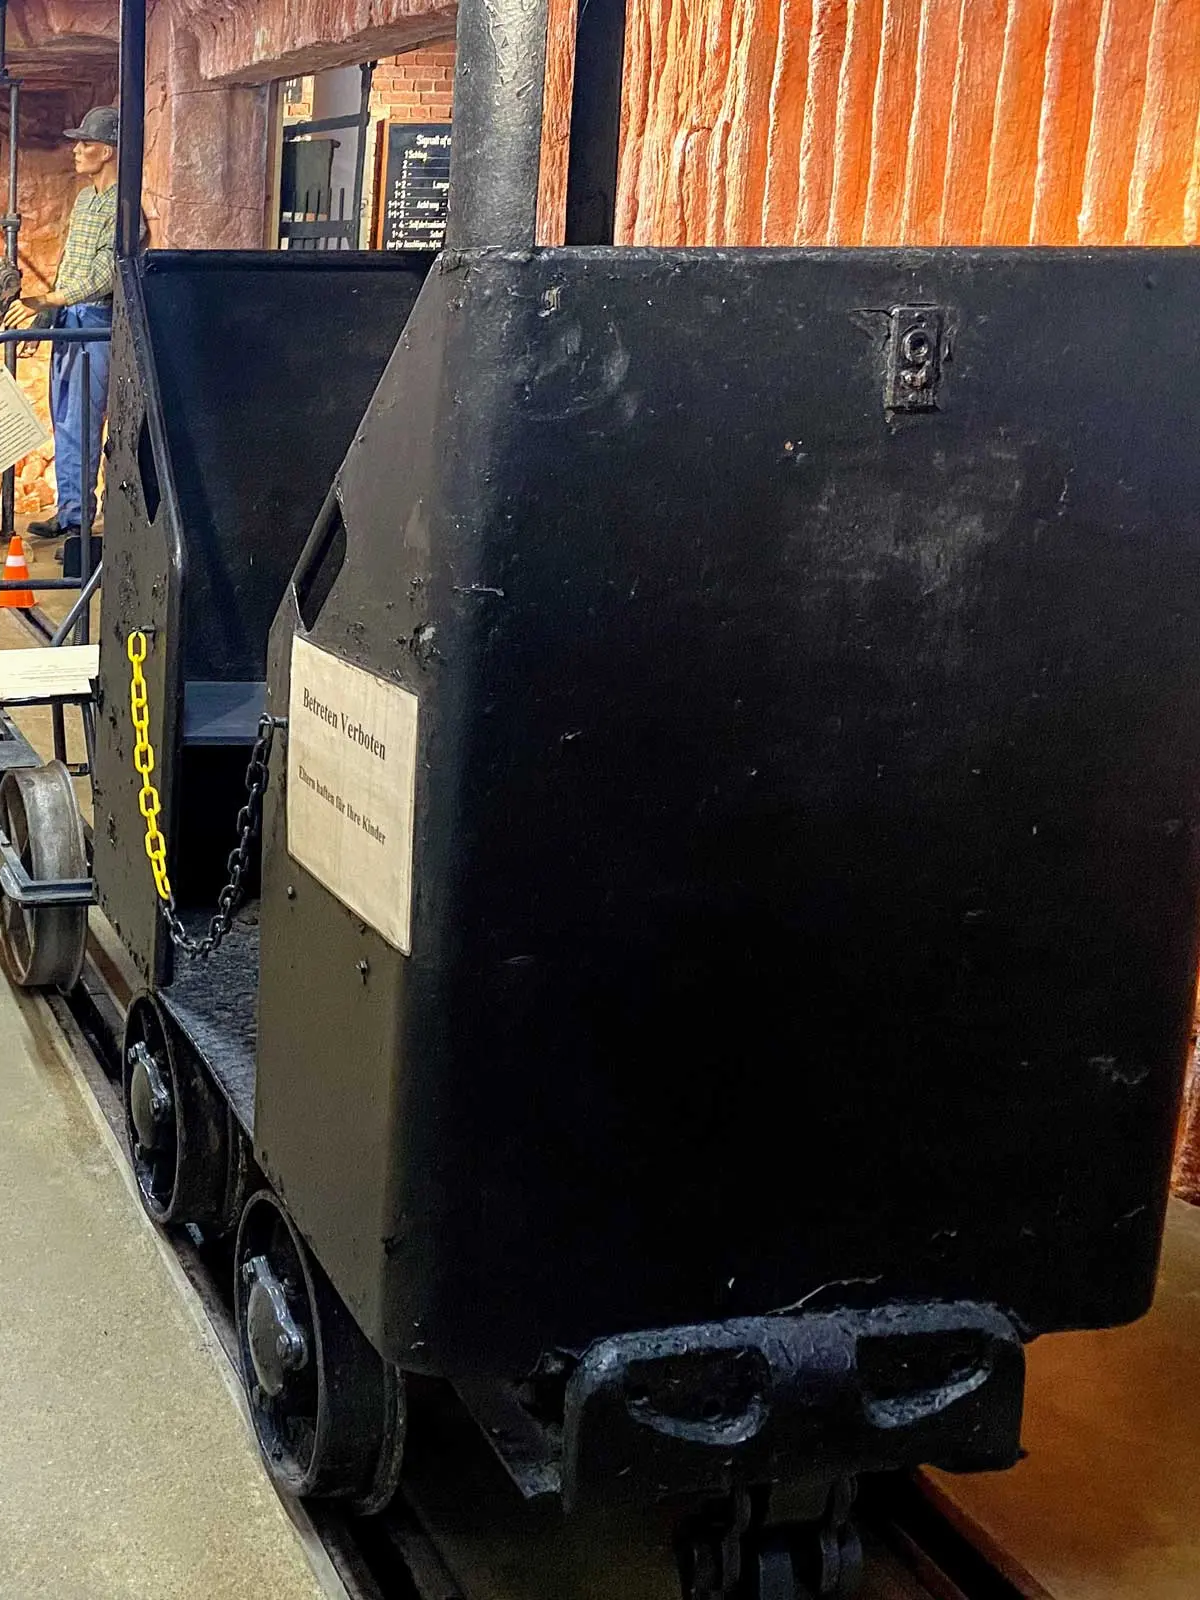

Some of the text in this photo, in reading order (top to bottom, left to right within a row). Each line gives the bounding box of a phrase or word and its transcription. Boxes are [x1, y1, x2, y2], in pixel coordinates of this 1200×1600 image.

[416, 134, 451, 148] Signaltafe
[303, 686, 386, 761] Betreten Verboten
[316, 778, 335, 806] haften
[335, 795, 346, 814] für
[346, 803, 361, 826] Ihre
[362, 815, 386, 845] Kinder
